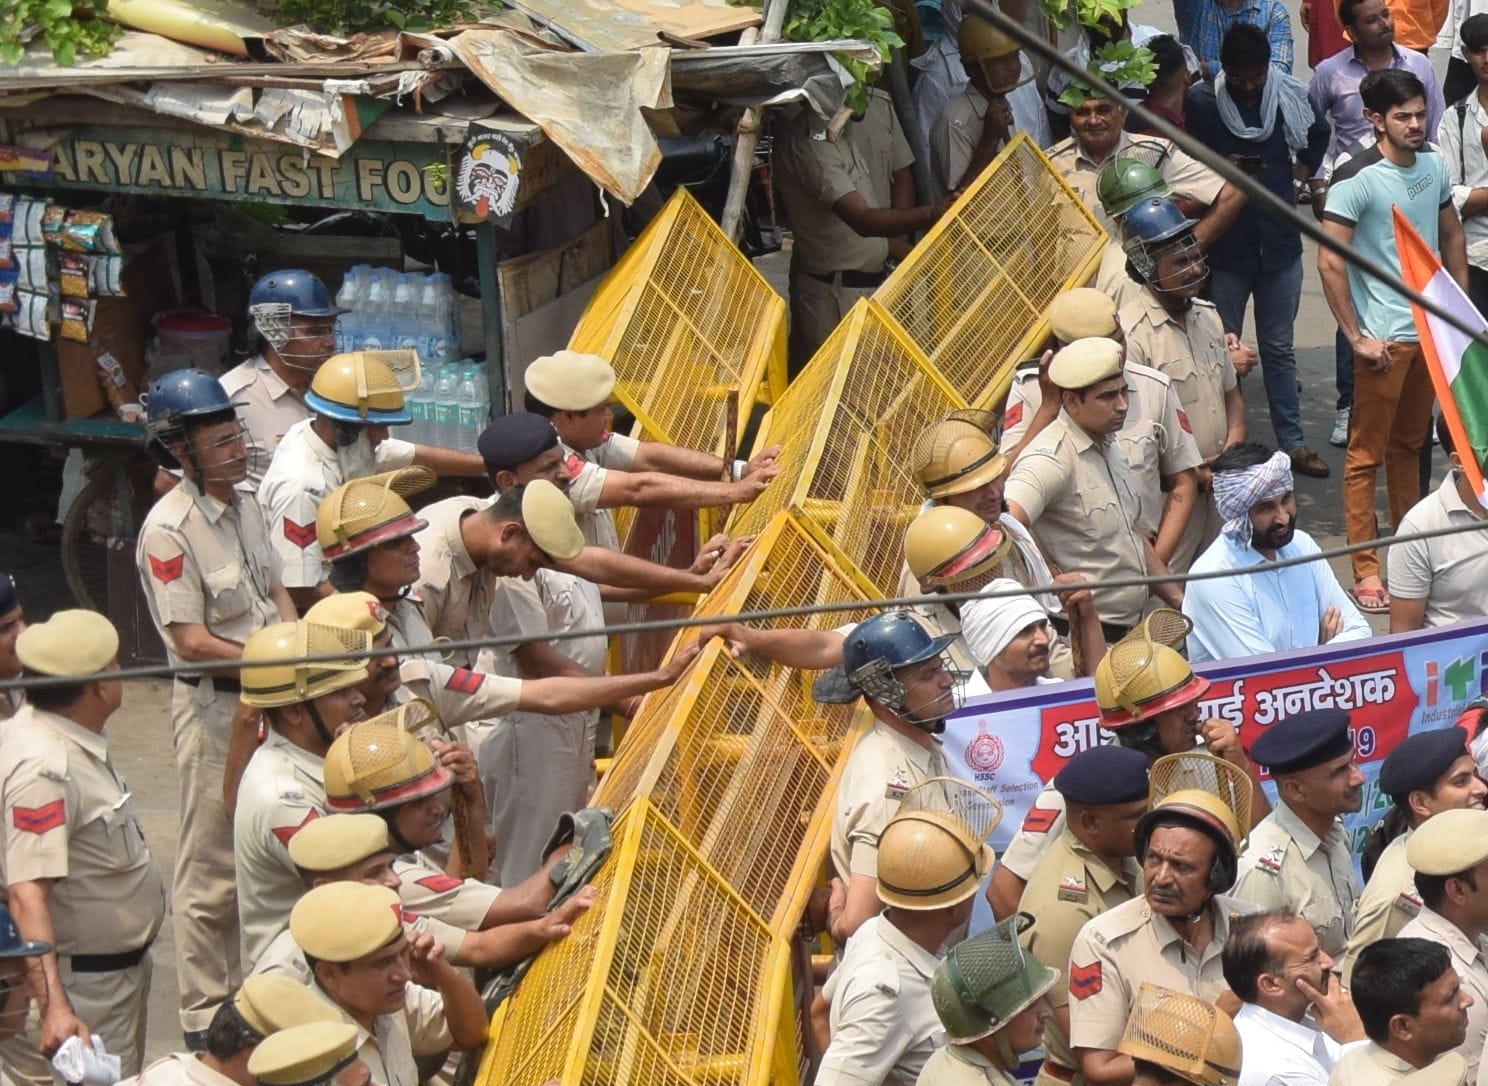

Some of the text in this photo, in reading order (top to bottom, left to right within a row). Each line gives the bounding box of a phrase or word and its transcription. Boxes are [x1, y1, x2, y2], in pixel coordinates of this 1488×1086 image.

[51, 140, 206, 191] ARYAN
[220, 151, 340, 198] FAST
[1253, 667, 1397, 725] अनदेशक
